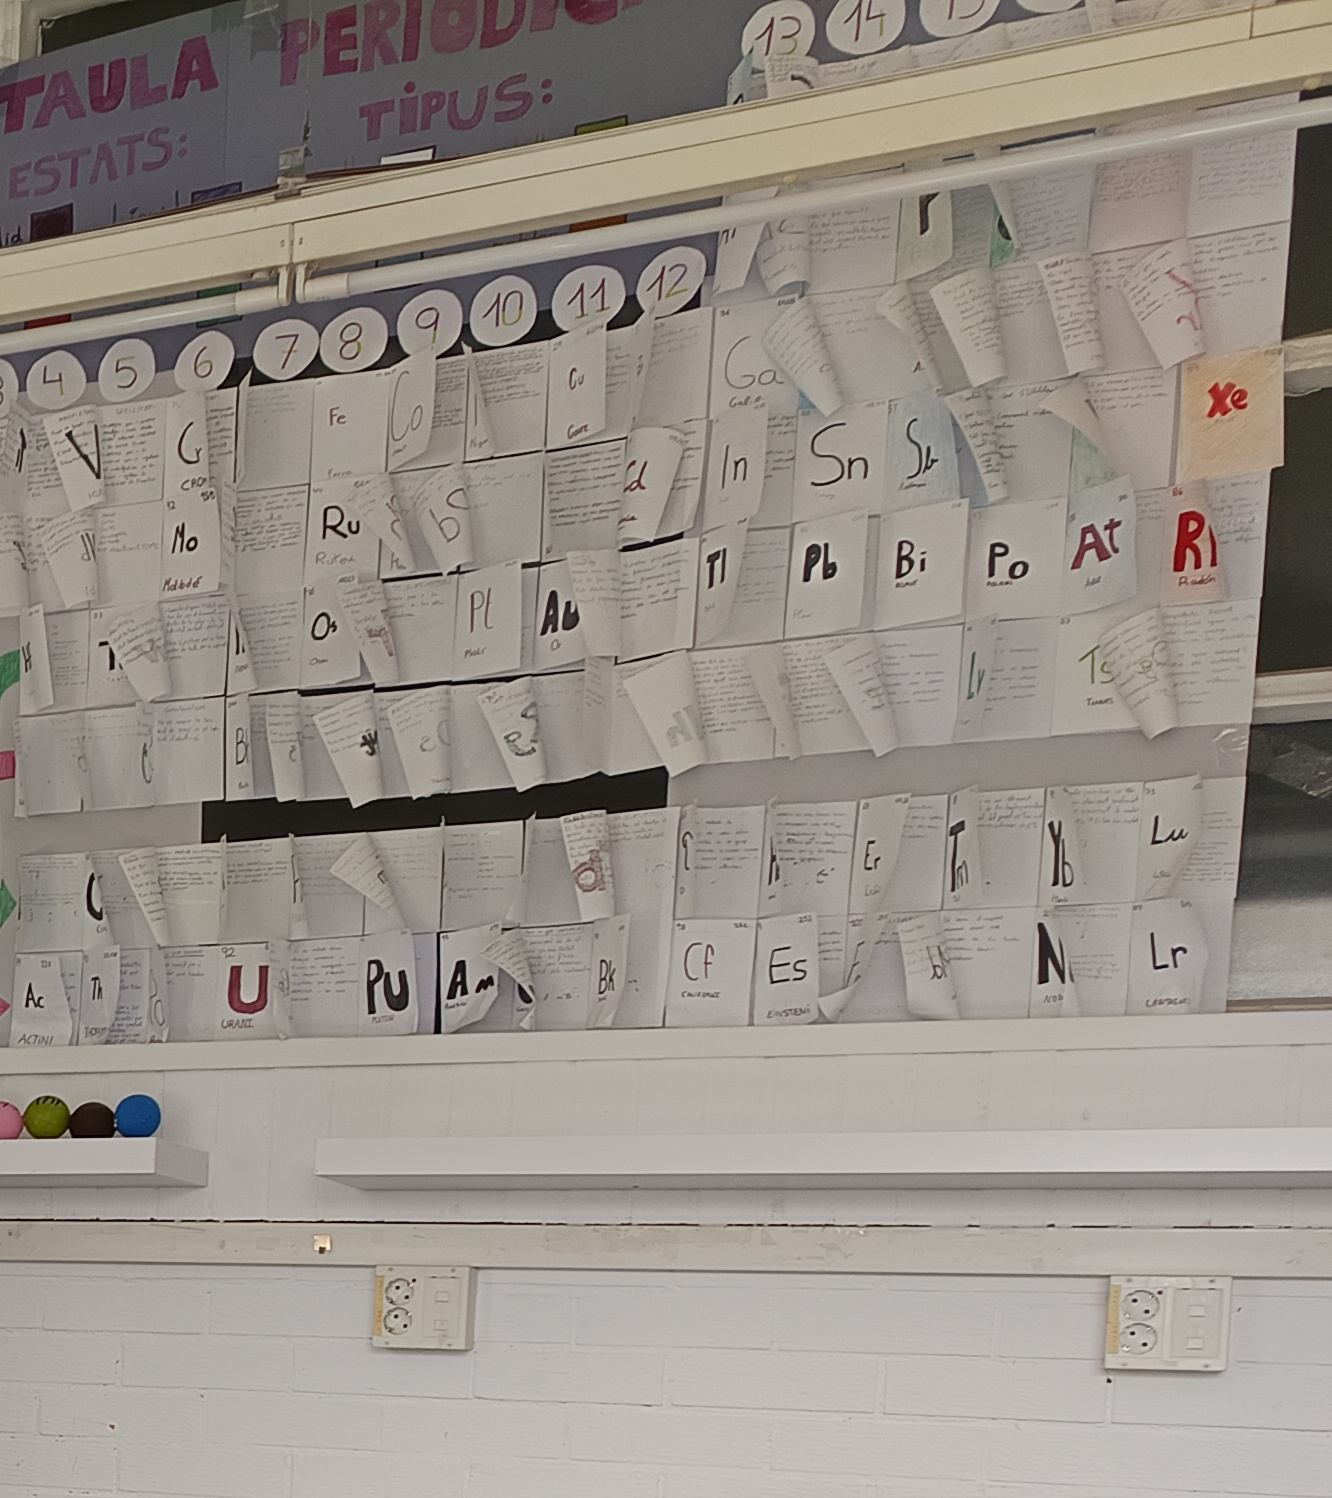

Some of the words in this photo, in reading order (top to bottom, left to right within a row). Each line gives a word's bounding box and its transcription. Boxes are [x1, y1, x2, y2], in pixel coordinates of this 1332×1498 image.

[754, 15, 802, 56] 13
[843, 0, 886, 42] 14
[9, 126, 188, 200] ESTATS:
[567, 277, 612, 320] 11
[645, 263, 689, 301] 12
[415, 307, 440, 346] 9
[482, 289, 524, 328] 10
[276, 334, 300, 370] 7
[338, 322, 363, 361] 8
[42, 365, 65, 397] 4
[116, 356, 138, 389] 5
[193, 345, 214, 378] 6
[329, 406, 348, 427] Fe
[1206, 380, 1249, 420] Xe
[721, 443, 748, 490] In
[810, 422, 869, 488] Sn
[171, 521, 198, 554] Mo
[321, 505, 361, 541] Ru
[802, 541, 838, 583] Pb
[894, 539, 927, 580] Bi
[987, 542, 1030, 580] Po
[1070, 517, 1123, 571] At
[469, 588, 494, 634] Pt
[540, 588, 580, 637] Au
[1150, 814, 1189, 846] Lu
[864, 839, 881, 871] Er
[683, 941, 715, 982] Cf
[768, 946, 808, 985] Es
[1150, 932, 1188, 971] Lr
[24, 982, 45, 1009] Ac
[227, 964, 270, 1015] U
[366, 958, 410, 1016] Pu
